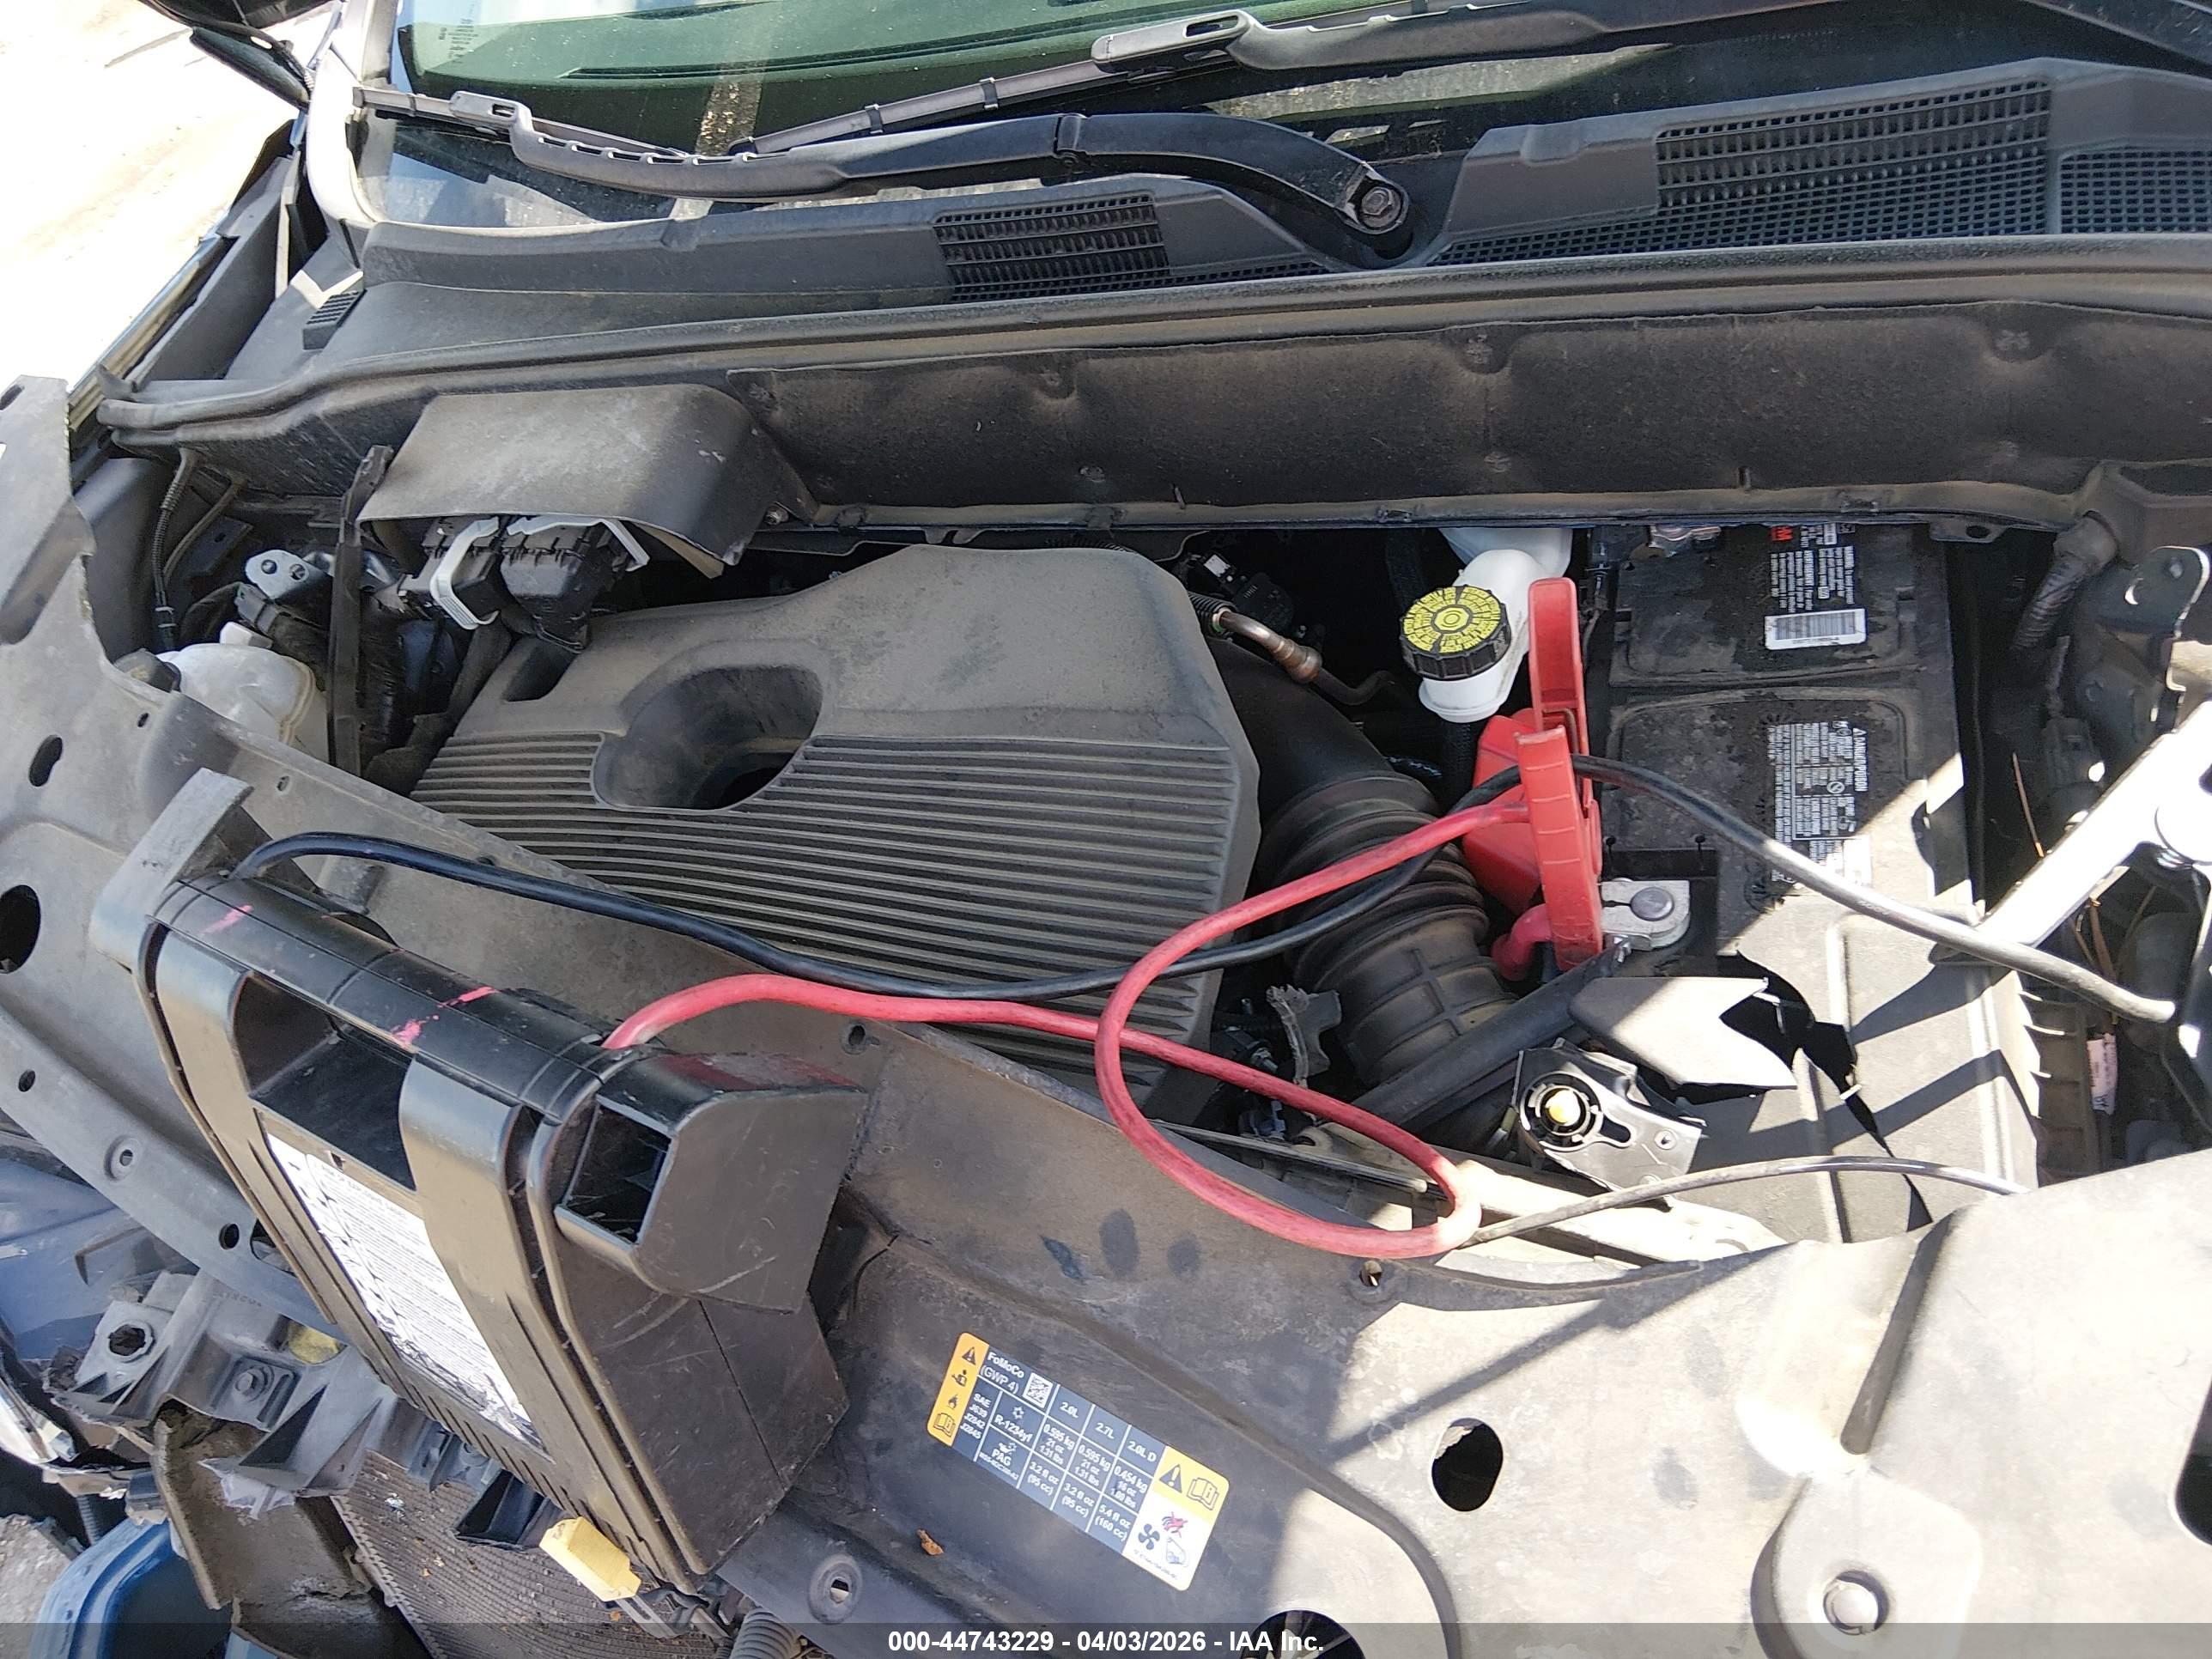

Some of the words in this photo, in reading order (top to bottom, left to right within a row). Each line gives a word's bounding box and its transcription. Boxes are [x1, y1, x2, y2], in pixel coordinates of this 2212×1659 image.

[987, 1352, 1024, 1377] FoMoCo
[980, 1365, 1008, 1384] (GWP
[1006, 1381, 1018, 1394] 4)
[991, 1448, 1012, 1466] PAG
